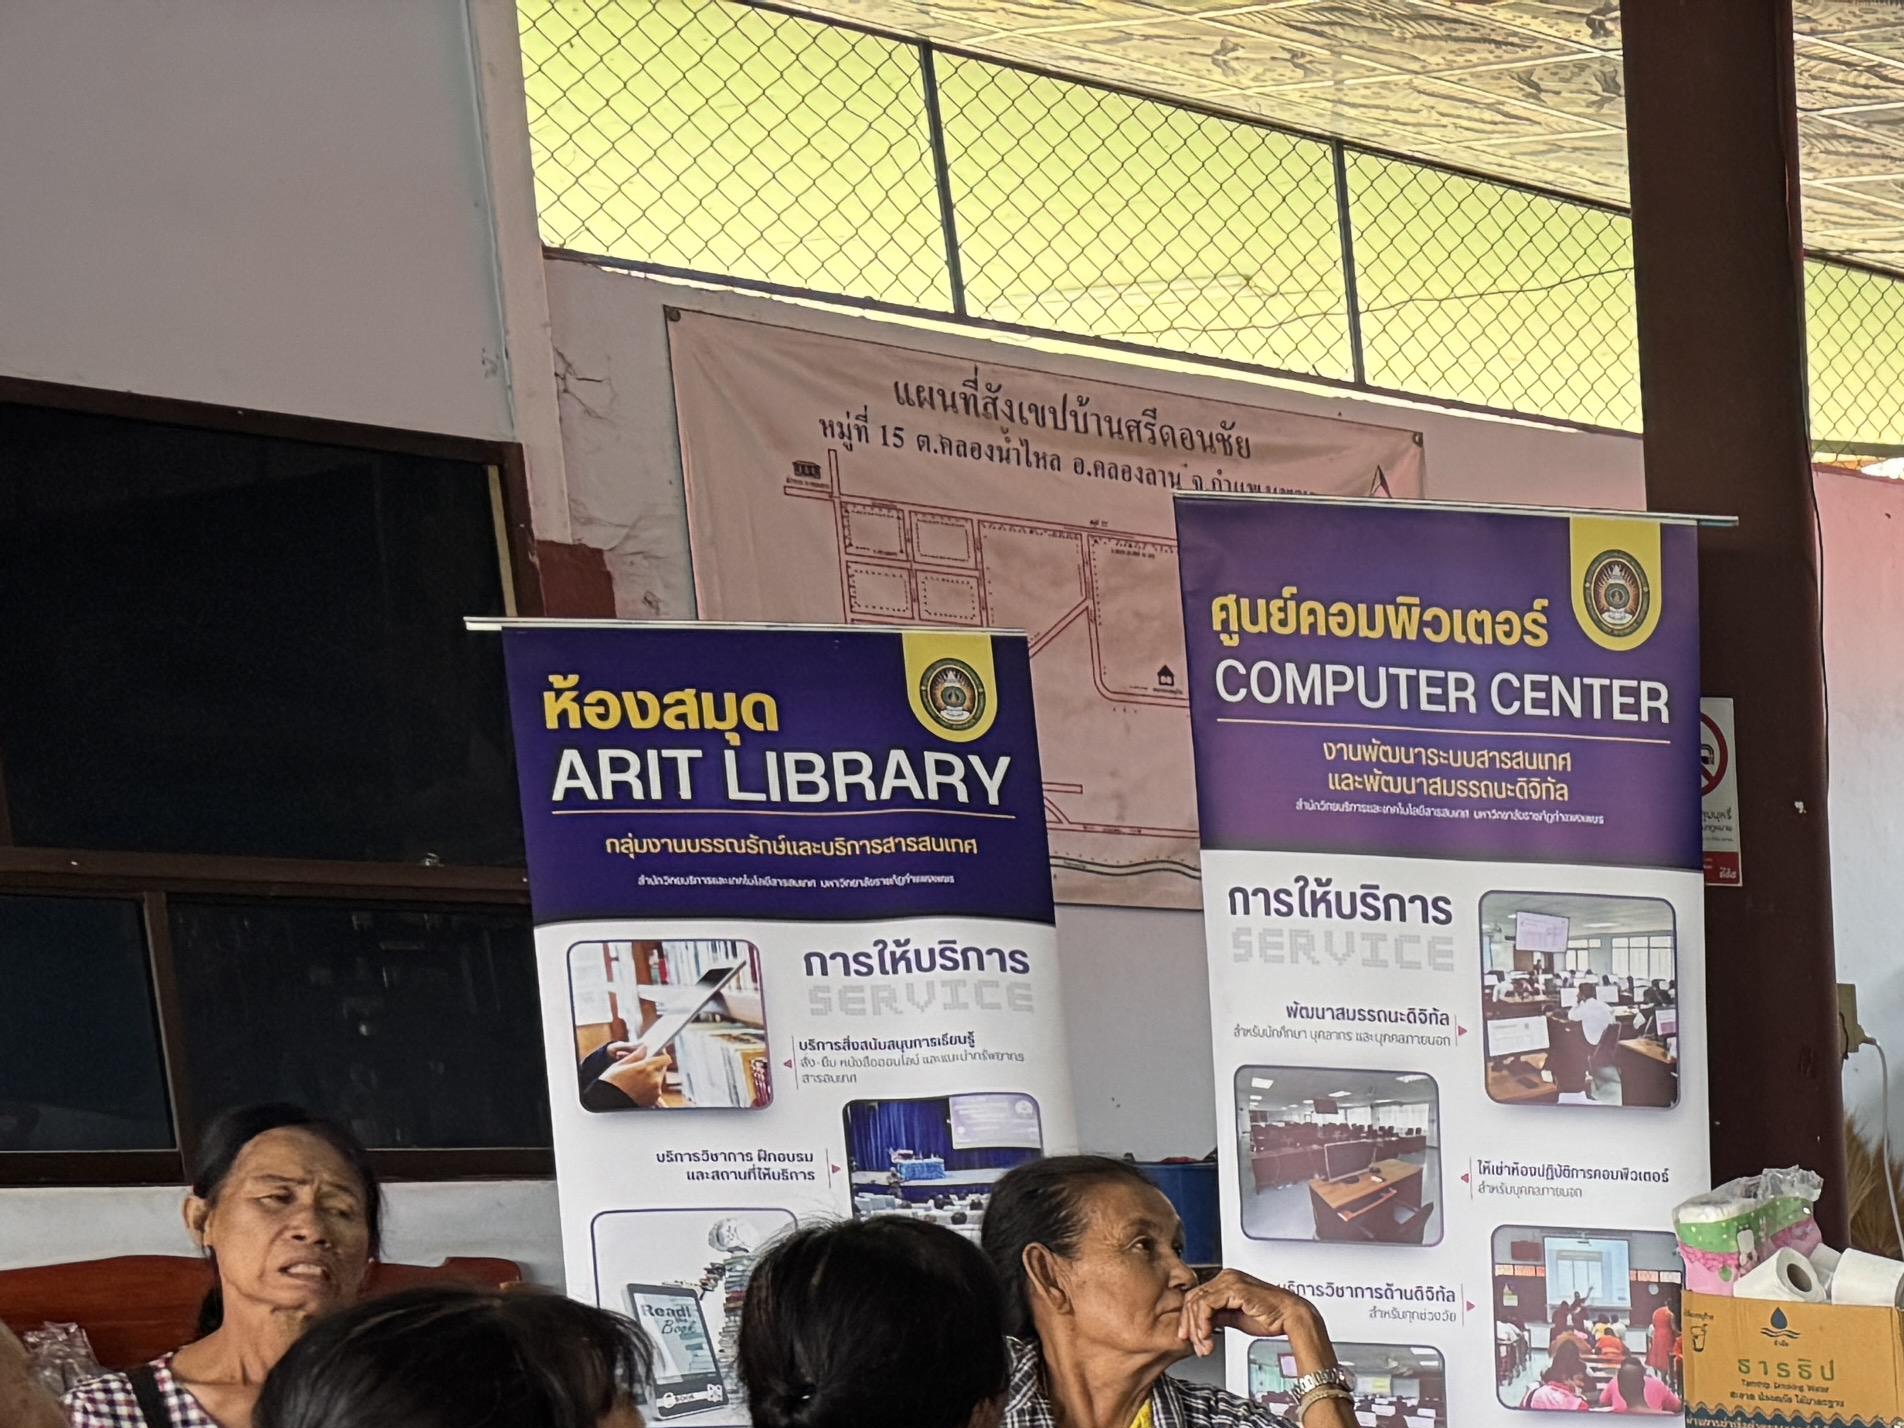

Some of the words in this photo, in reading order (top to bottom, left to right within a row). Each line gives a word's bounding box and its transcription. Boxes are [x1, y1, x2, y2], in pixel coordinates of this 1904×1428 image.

[894, 365, 1251, 459] แผนที่สังเขปบ้านศรีดอนชัย
[819, 406, 870, 452] หมู่ที่
[881, 425, 905, 448] 15
[917, 427, 1062, 473] ต.คลองน้ำไหล
[1073, 456, 1182, 489] อ.คลองลาน
[1211, 586, 1549, 648] ศูนย์คอมพิวเตอร์
[1215, 658, 1477, 714] COMPUTER
[1490, 671, 1670, 723] CENTER
[543, 674, 779, 746] ห้องสมุด
[1323, 738, 1572, 773] งานพัฒนาระบบสารสนเทศ
[552, 748, 703, 802] ARIT
[724, 749, 1011, 806] LIBRARY
[1328, 768, 1569, 802] และพัฒนาสมรรถนะดิจิทัล
[606, 832, 977, 859] กลุ่มงานบรรณรักษ์และบริการสารสนเทศ
[1228, 876, 1453, 926] การให้บริการ
[804, 938, 1030, 977] การให้บริการ
[1231, 927, 1455, 972] SERVICE
[808, 979, 1035, 1016] SERVICE
[1286, 1001, 1450, 1026] พัฒนาสมรรถนะดิจิทัล
[799, 1031, 976, 1053] บริการสิ่งสนับสนุนการเรียนรู้
[656, 1150, 753, 1163] บริการวิชาการ
[757, 1149, 813, 1163] ฝึกอบรม
[687, 1165, 815, 1181] และสถานที่ให้บริการ
[1478, 1159, 1669, 1183] ให้เช่าห้องปฏิบัติการคอมพิวเตอร์
[1278, 1280, 1456, 1302] ริการวิชาการด้านดิจิทัล
